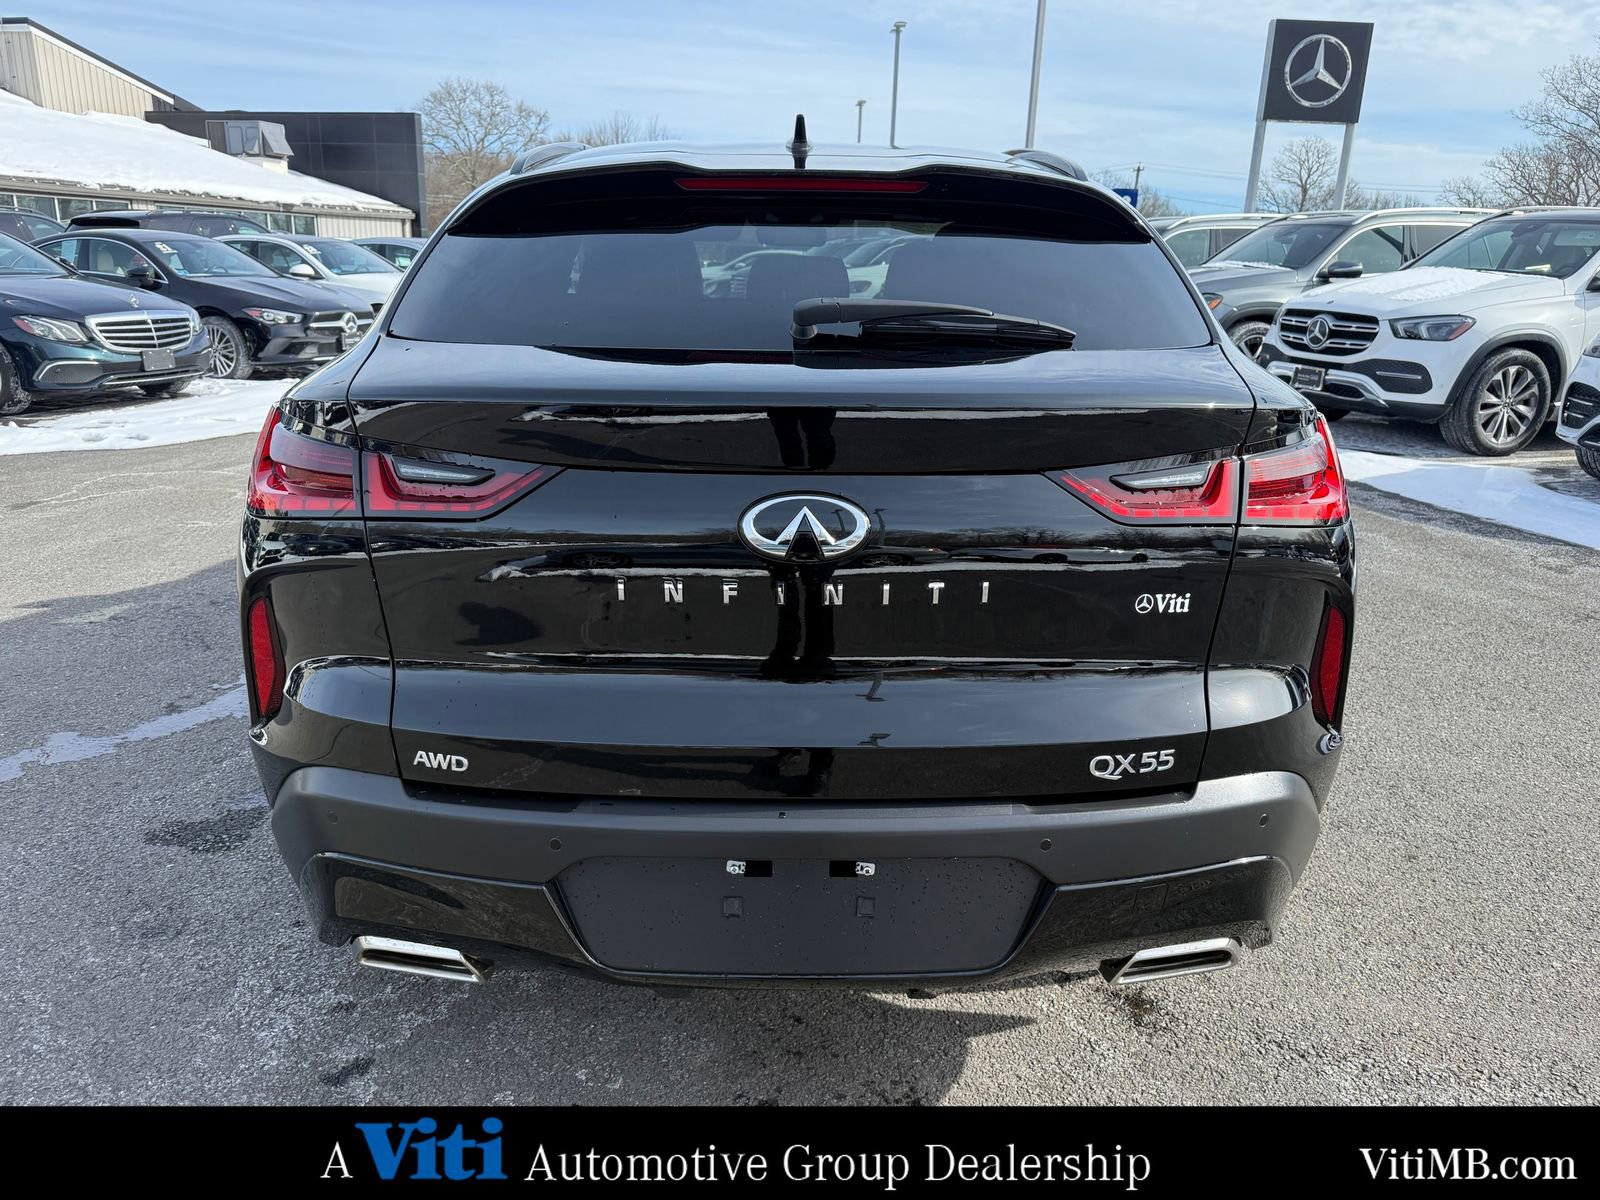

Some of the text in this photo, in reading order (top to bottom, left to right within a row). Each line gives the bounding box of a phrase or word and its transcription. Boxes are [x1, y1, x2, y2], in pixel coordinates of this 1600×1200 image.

[617, 578, 990, 606] INFINITI
[1155, 592, 1191, 614] Viti
[412, 750, 469, 772] AWD
